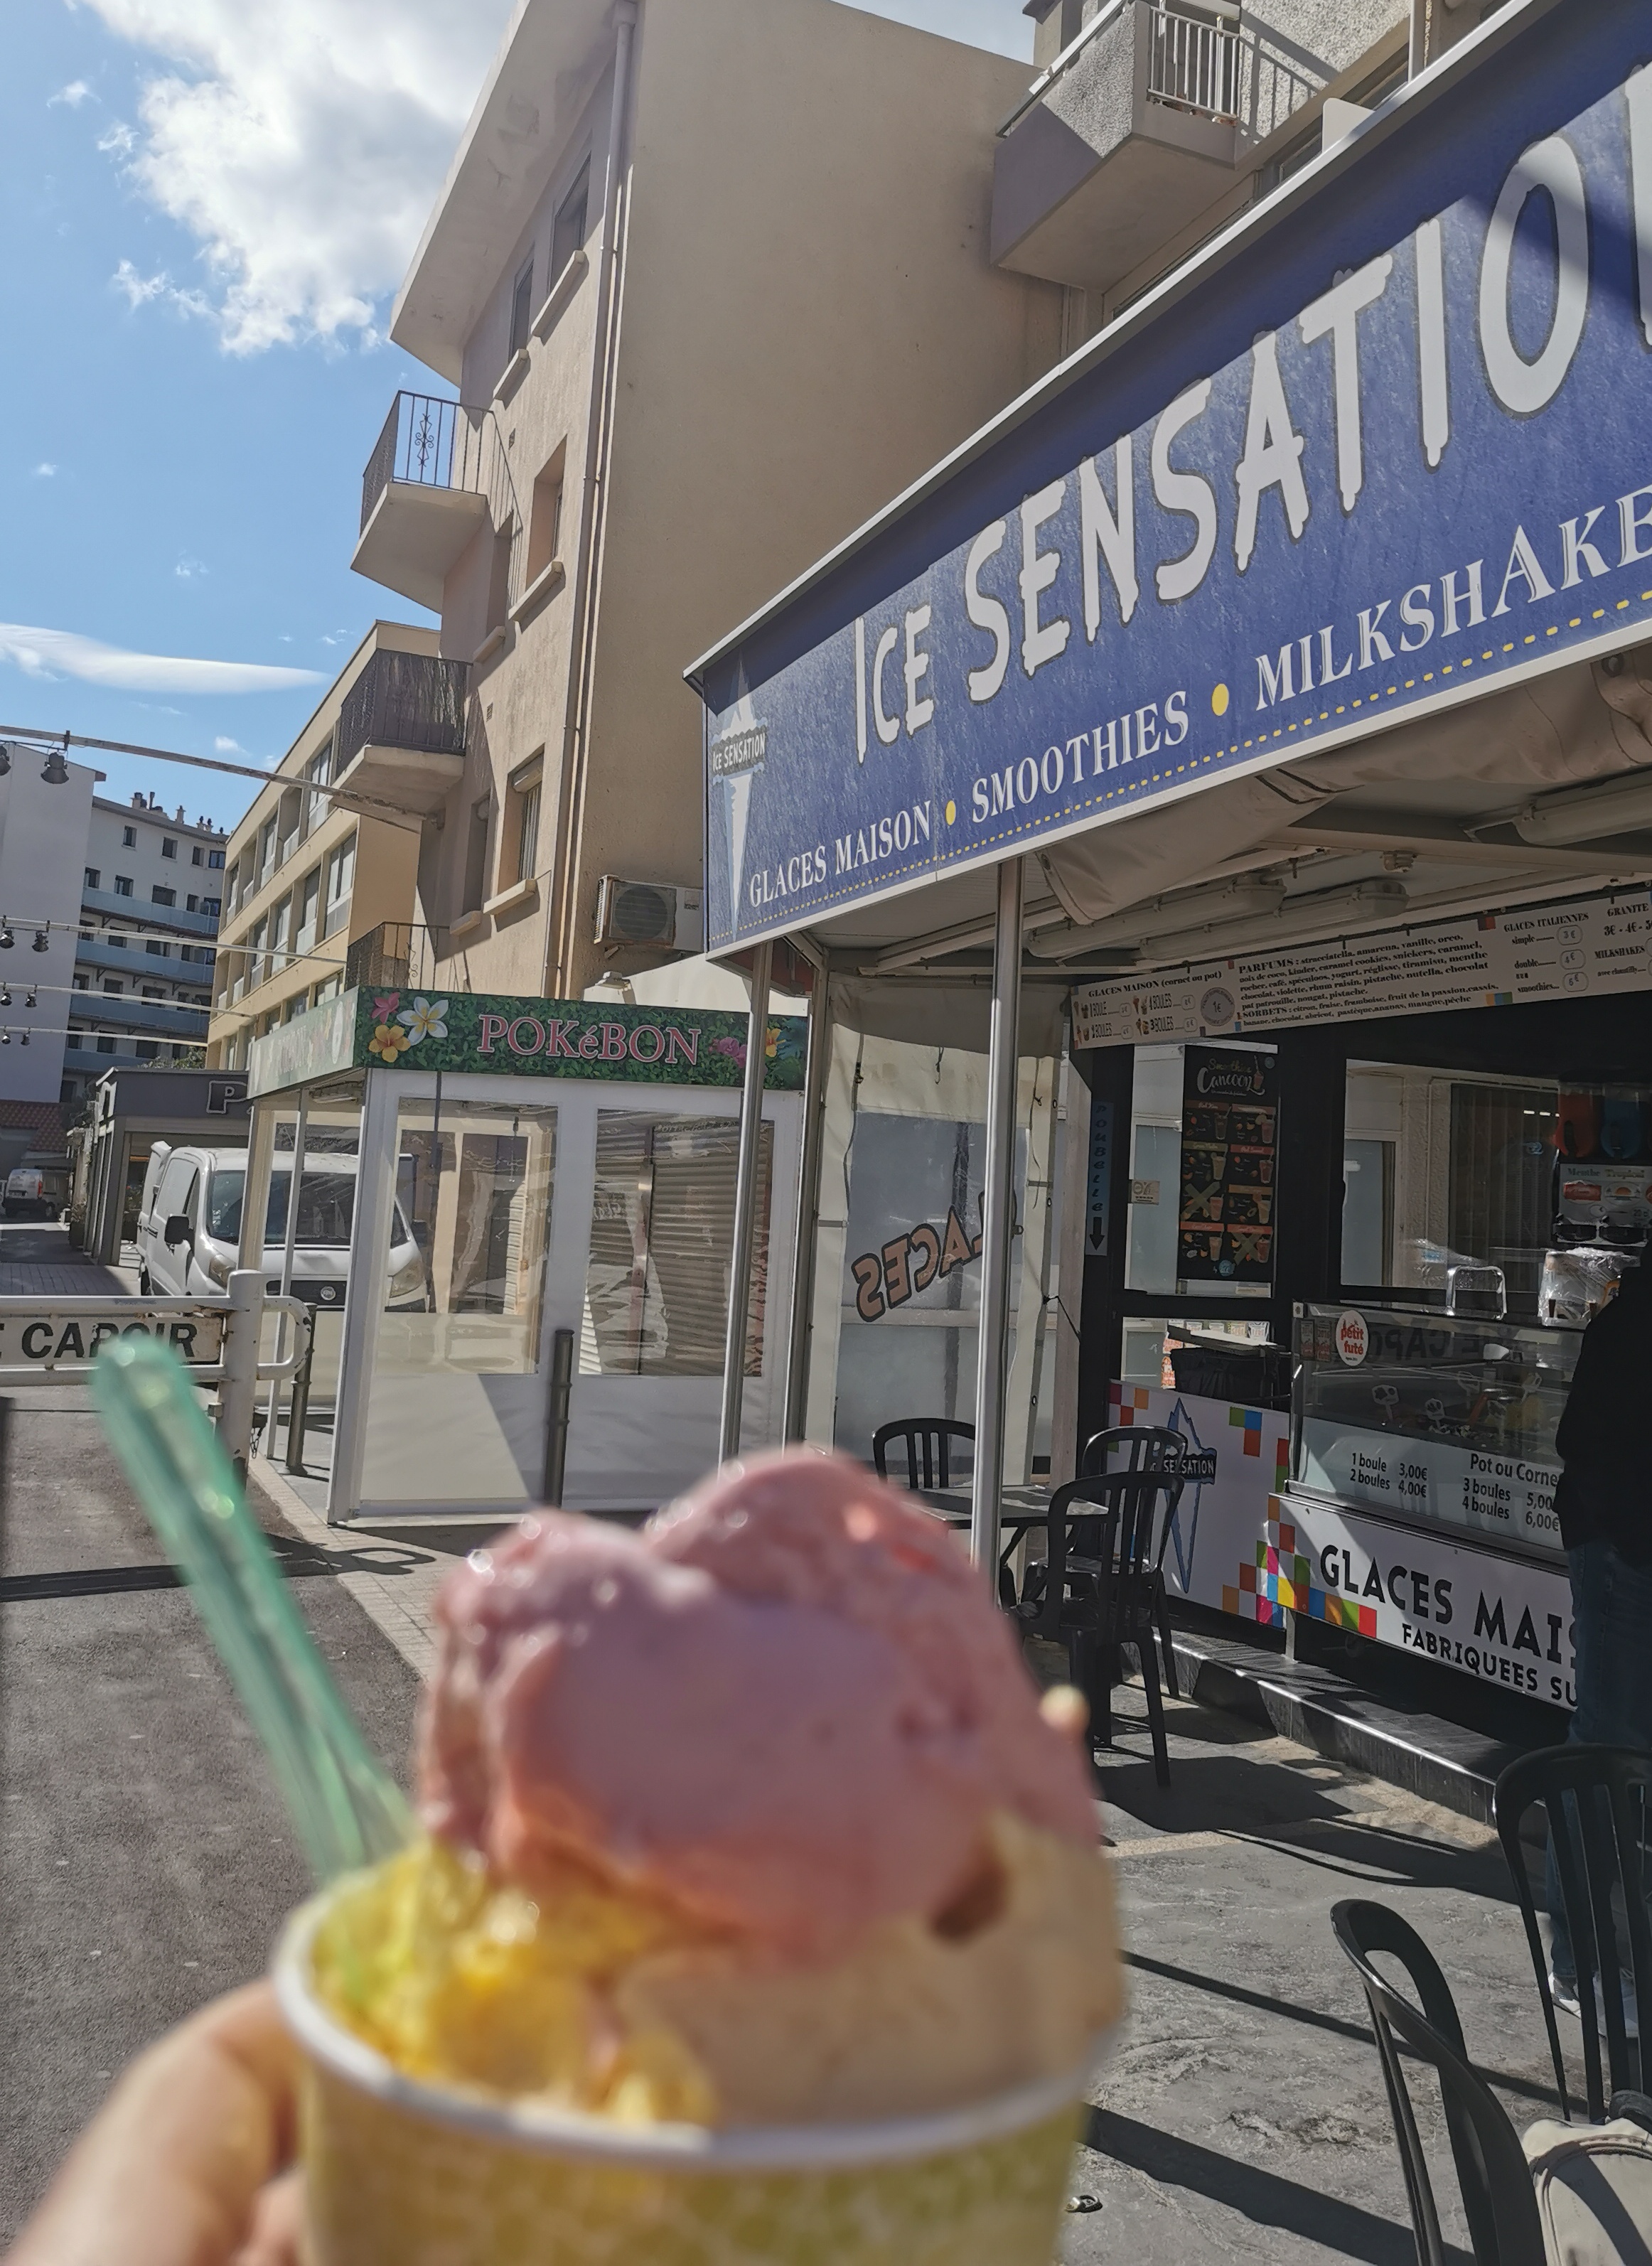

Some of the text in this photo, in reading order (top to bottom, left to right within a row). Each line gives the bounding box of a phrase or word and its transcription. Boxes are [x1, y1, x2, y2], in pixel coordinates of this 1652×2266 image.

[855, 60, 1652, 763] ICE SENSATIO
[713, 732, 766, 772] ICE SENSATION
[749, 845, 827, 908] GLACES
[835, 800, 931, 876] MAISON
[971, 690, 1189, 823] SMOOTHIES
[1504, 913, 1589, 933] GLACES ITALIENNES
[1449, 952, 1488, 962] menthe
[1594, 946, 1645, 958] MILKSHAKES
[1239, 958, 1294, 974] PARFUMS
[1319, 960, 1353, 970] caramel
[1445, 962, 1489, 973] chocolat
[1088, 988, 1122, 998] GLACES
[1124, 980, 1159, 992] MAISON
[1243, 1007, 1287, 1018] SORBETS
[476, 1013, 702, 1065] POKéBON
[1343, 1341, 1363, 1355] futé
[1164, 1459, 1214, 1475] SESATION
[1352, 1453, 1427, 1481] 1 boule 3,00€
[1470, 1454, 1492, 1473] Pot
[1496, 1462, 1512, 1478] ou
[1351, 1469, 1427, 1498] 2 boules 4,00€
[1464, 1478, 1469, 1492] 3
[1473, 1478, 1511, 1501] boules
[1462, 1496, 1559, 1532] 4 boules 6,00€
[1320, 1545, 1453, 1625] GLACES
[1402, 1623, 1538, 1692] FABRIQUEES
